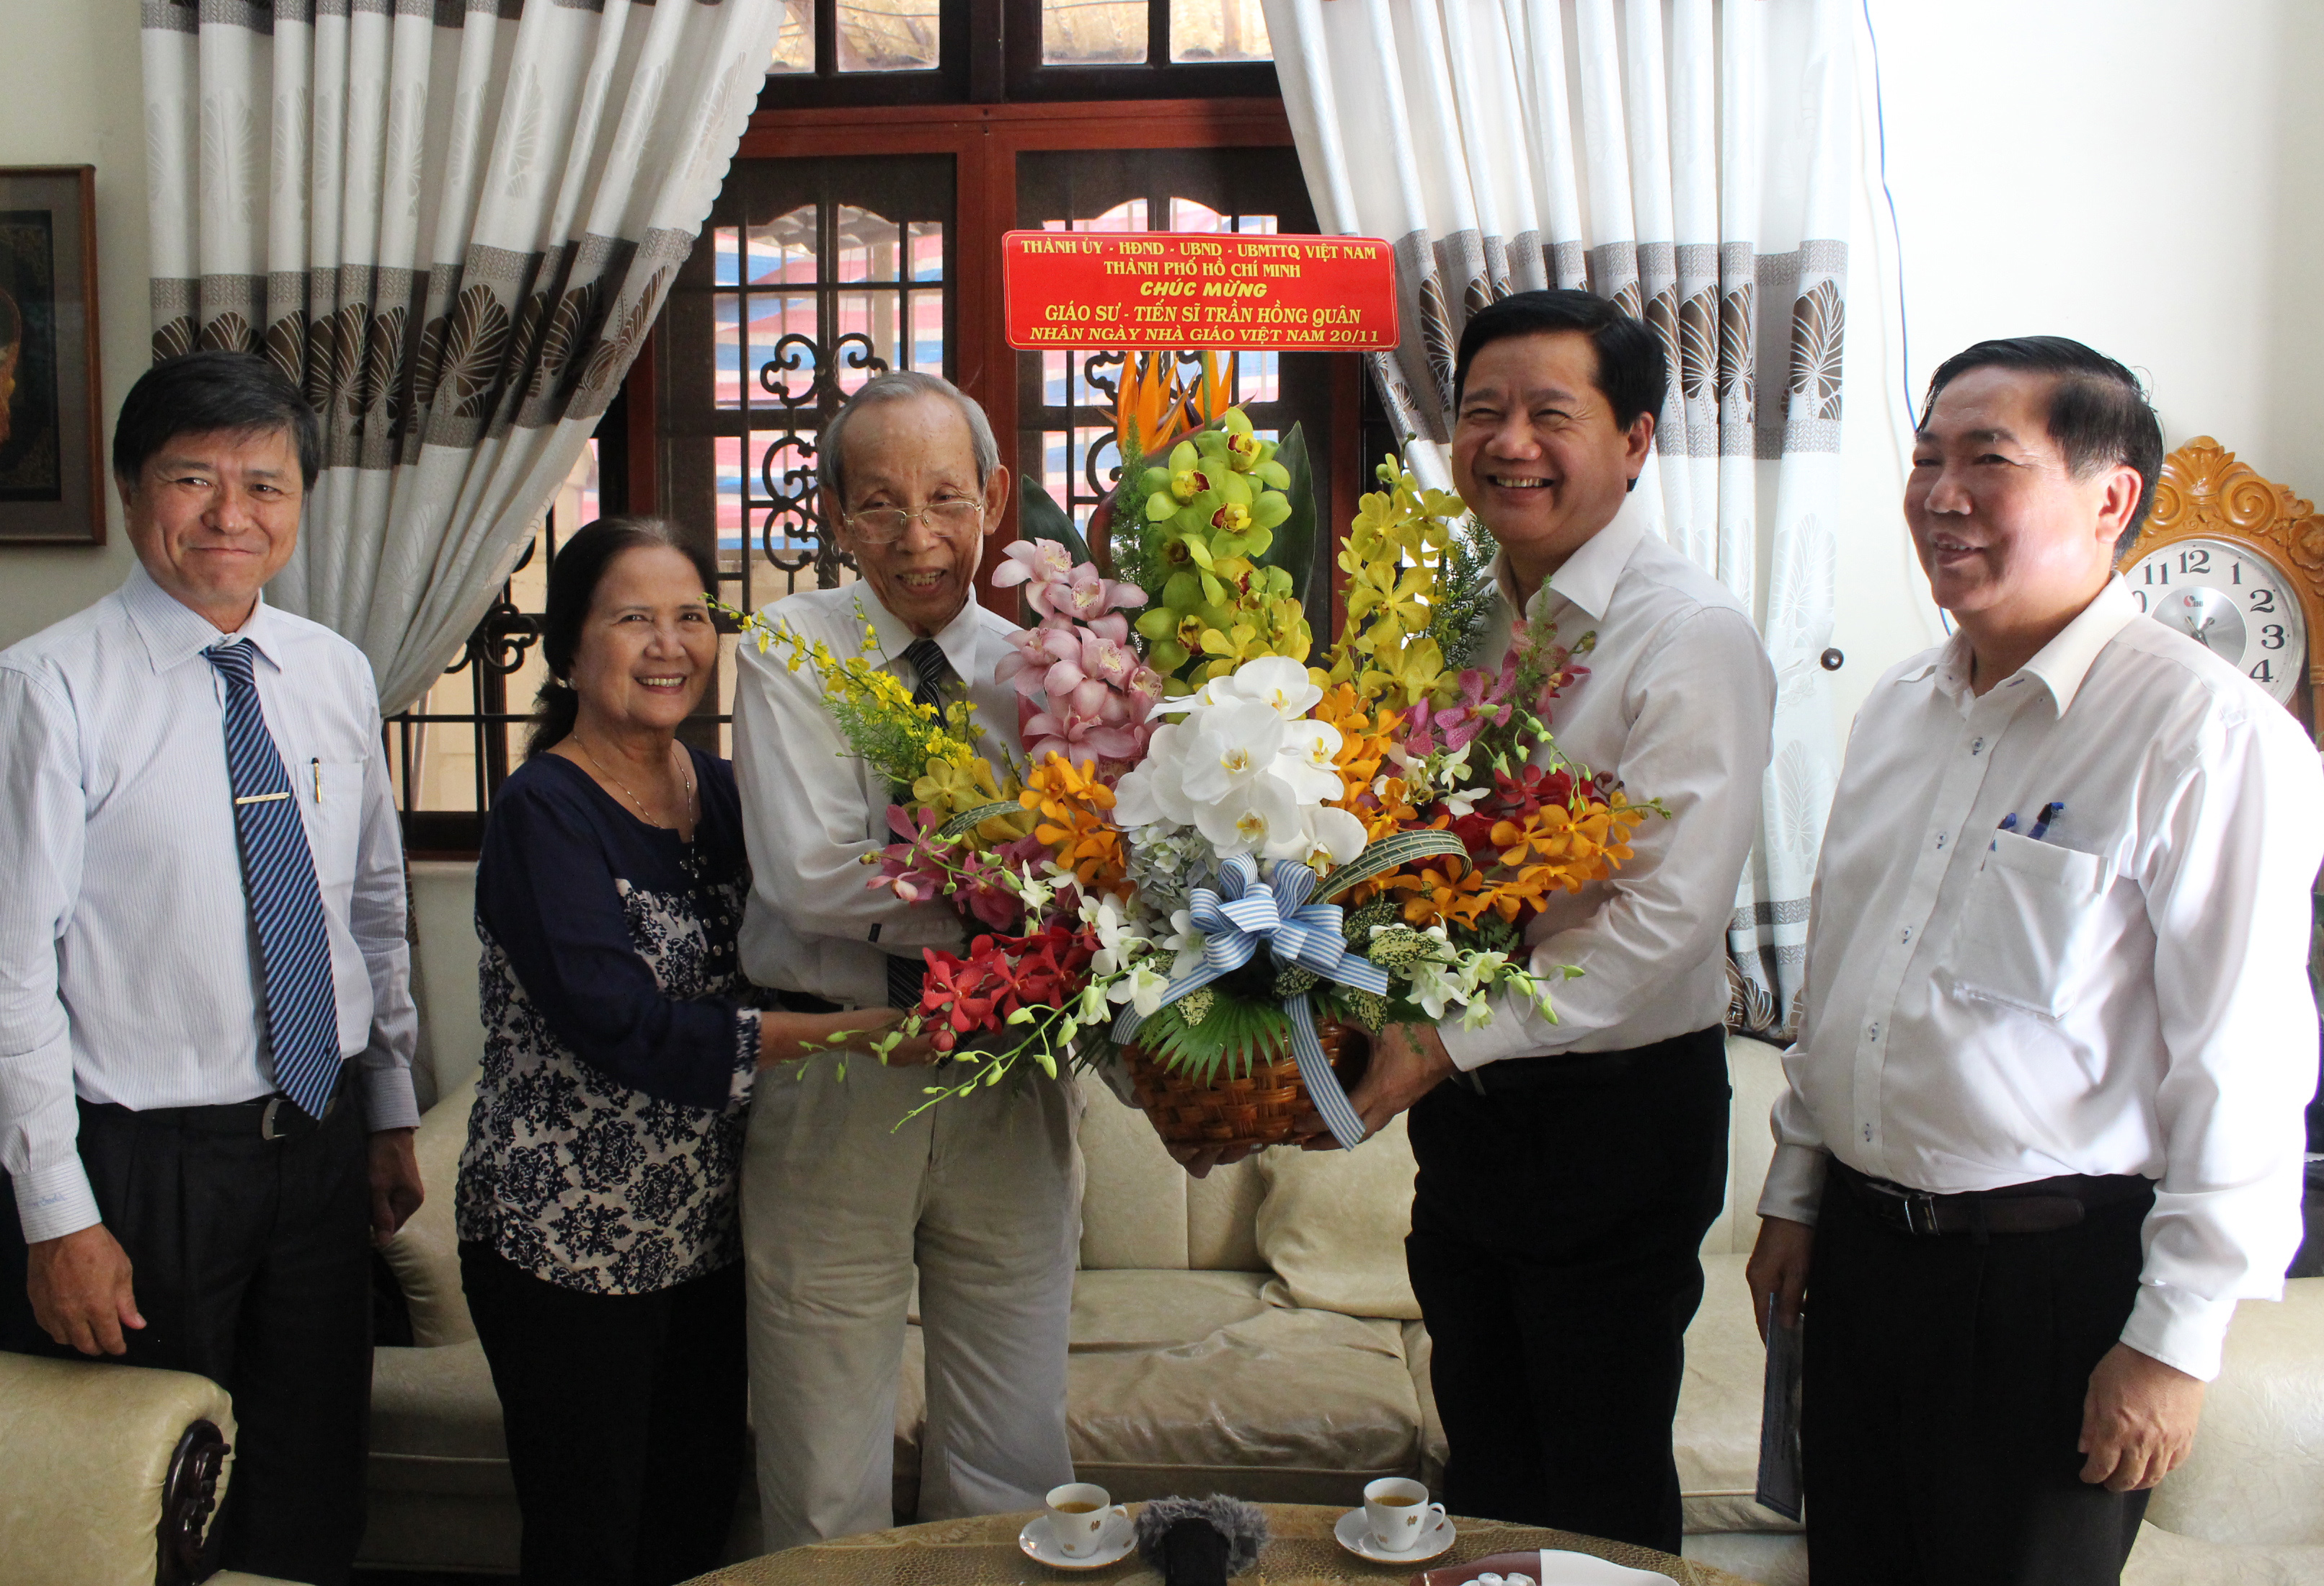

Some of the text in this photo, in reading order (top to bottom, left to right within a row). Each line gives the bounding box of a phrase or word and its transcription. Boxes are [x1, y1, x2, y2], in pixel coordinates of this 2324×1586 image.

[1021, 236, 1077, 254] THÀNH
[1082, 236, 1103, 254] ỦY
[1119, 242, 1164, 256] HĐND
[1180, 242, 1223, 257] UBND
[1238, 244, 1300, 260] UBMTTQ
[1305, 243, 1338, 262] VIỆT
[1344, 247, 1377, 260] NAM
[1104, 256, 1301, 278] THÀNH PHỐ HỒ CHÍ MINH
[1140, 278, 1267, 298] CHÚC MỪNG
[1045, 300, 1091, 321] GIÁO
[1095, 302, 1122, 322] SƯ
[1133, 298, 1178, 322] TIẾN
[1181, 303, 1201, 322] SĨ
[1205, 299, 1253, 323] TRẦN
[1257, 299, 1308, 324] HỒNG
[1312, 305, 1362, 328] QUÂN
[1029, 324, 1378, 344] NHÂN NGÀY NHÀ GIÁO VIỆT NAM 20/11
[2144, 562, 2169, 585] 11
[2178, 549, 2211, 575] 12
[2231, 562, 2242, 585] 1
[2250, 589, 2275, 613] 2
[2261, 624, 2284, 650] 3
[2248, 658, 2274, 683] 4
